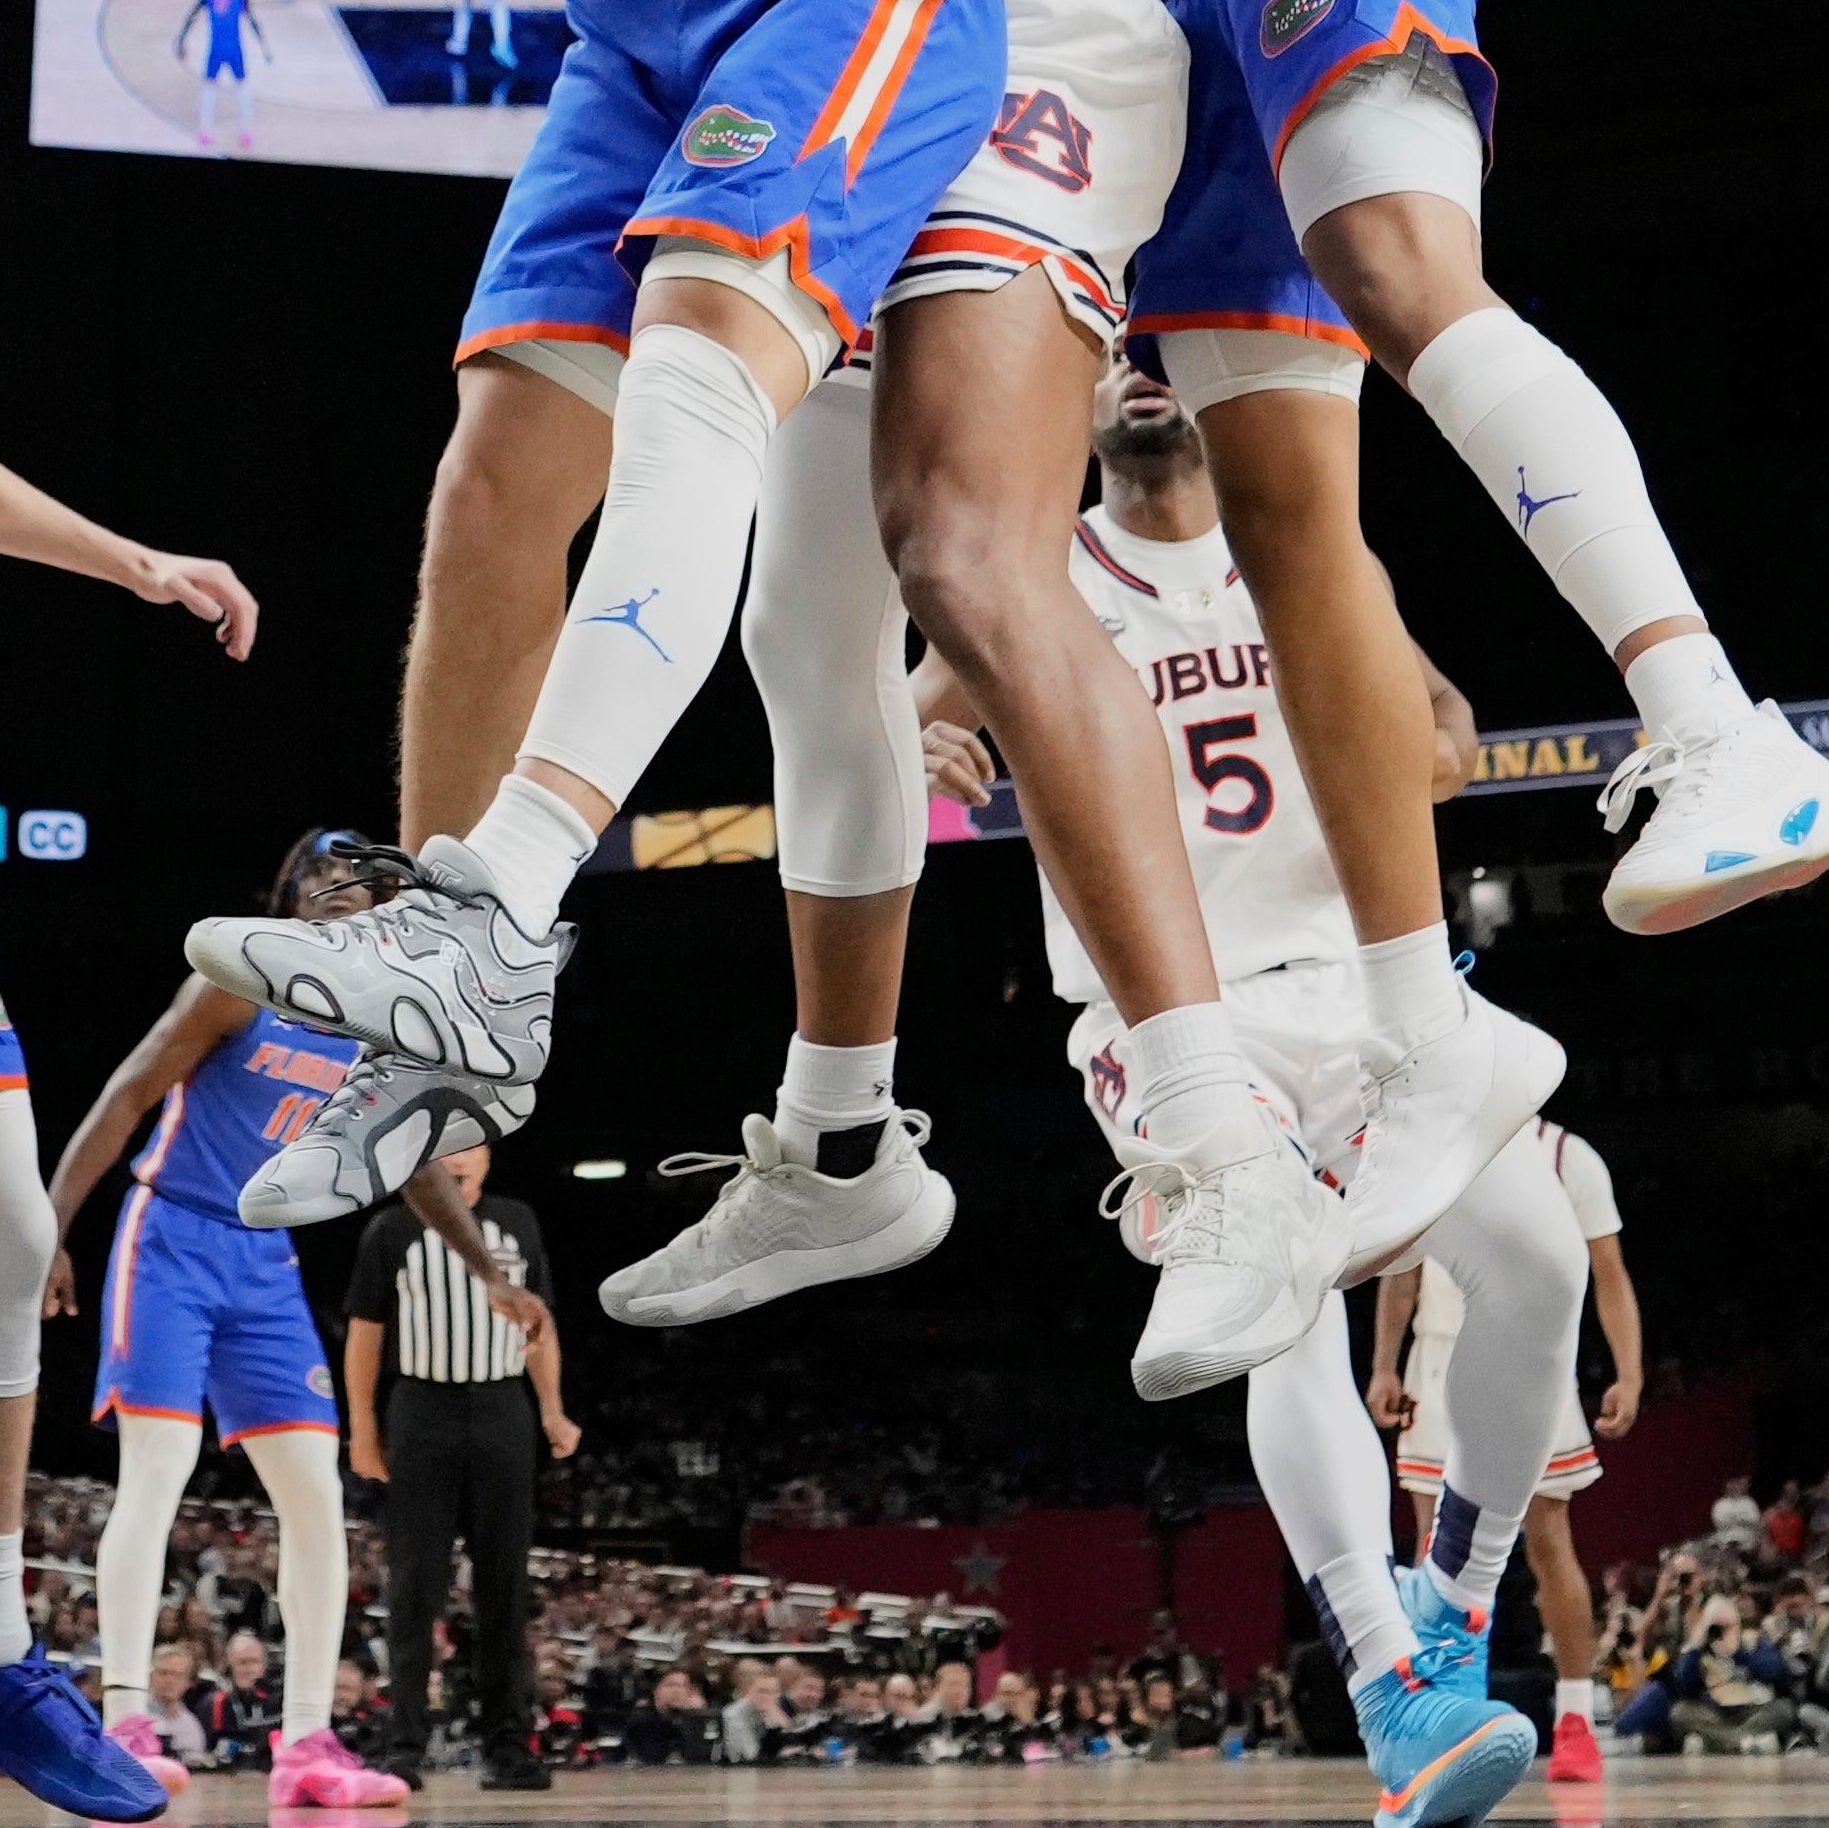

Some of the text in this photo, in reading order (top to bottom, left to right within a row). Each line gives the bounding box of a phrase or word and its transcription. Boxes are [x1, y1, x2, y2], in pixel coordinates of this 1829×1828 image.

[1183, 711, 1276, 836] 5
[1473, 734, 1601, 782] INAL
[27, 821, 75, 853] CC
